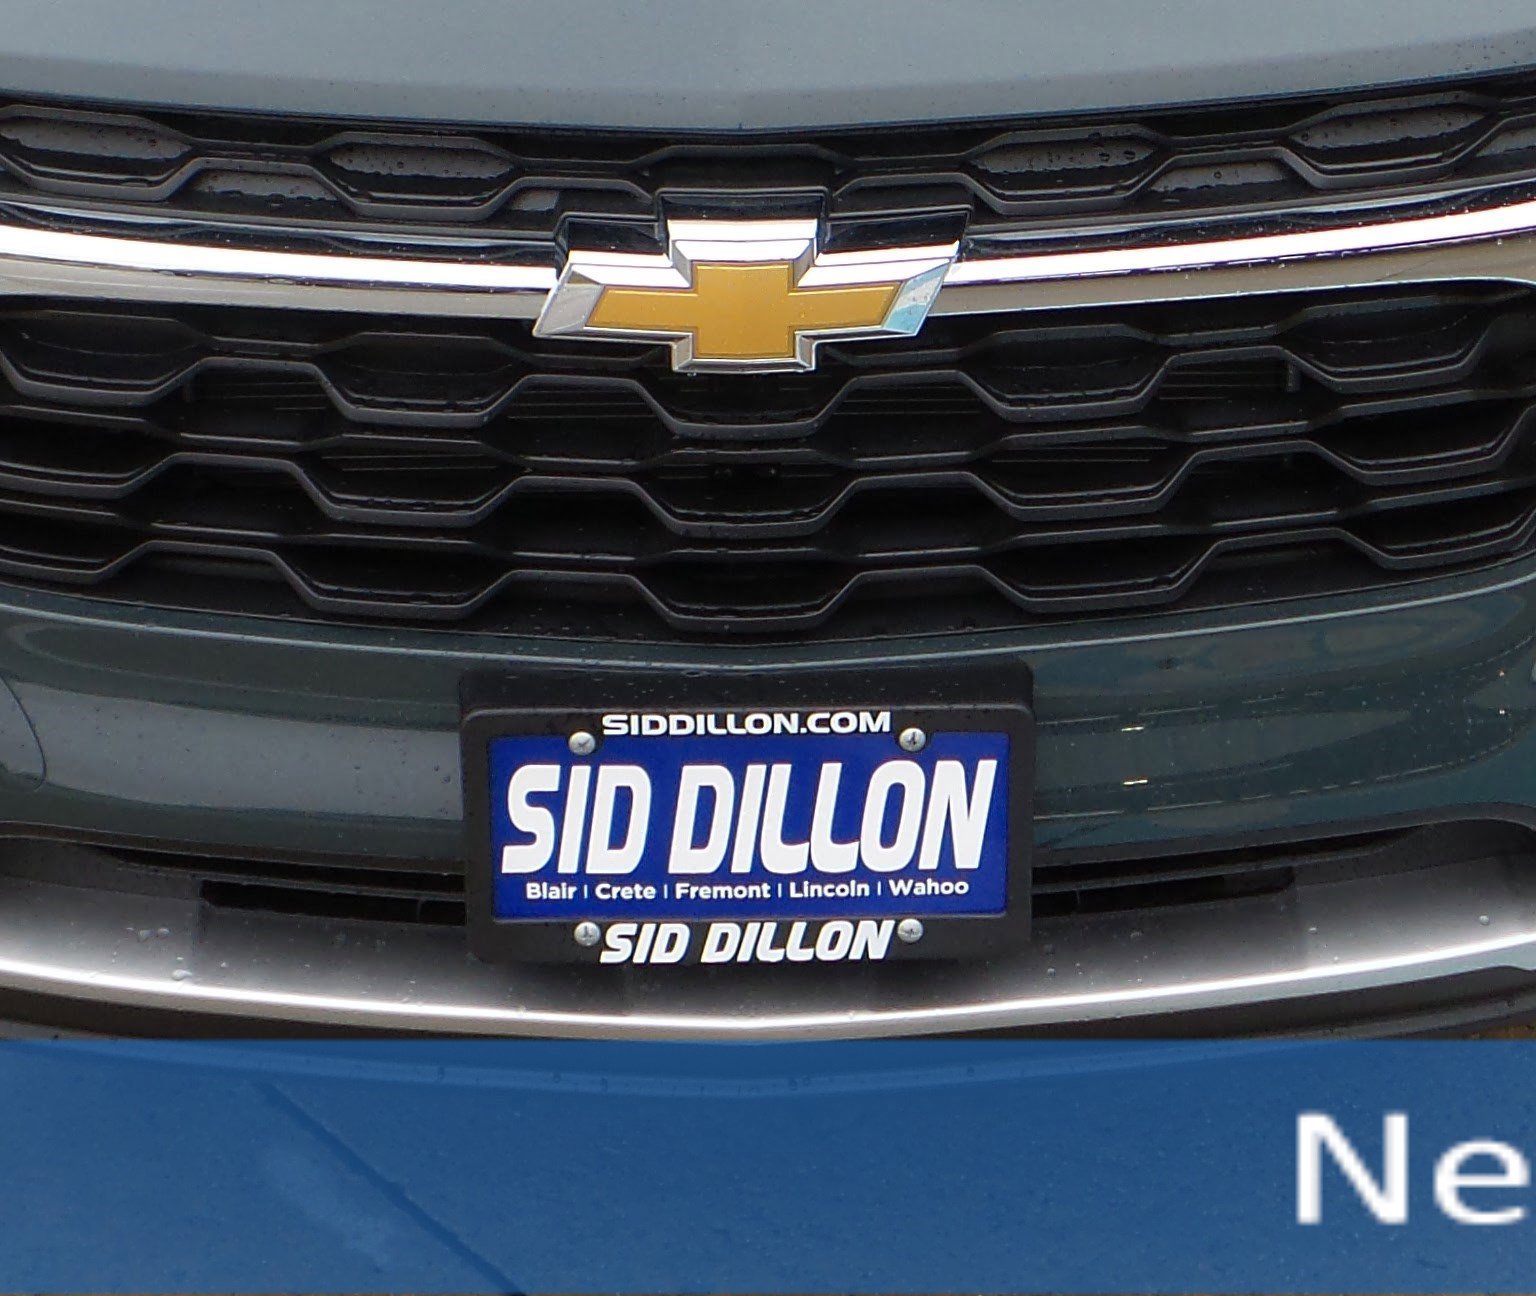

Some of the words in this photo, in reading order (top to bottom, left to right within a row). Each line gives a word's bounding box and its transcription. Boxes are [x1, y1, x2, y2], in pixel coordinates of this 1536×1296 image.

[601, 711, 892, 736] SIDDILLON.COM
[501, 764, 652, 875] SID
[668, 760, 998, 874] DILLON
[526, 881, 577, 900] Blair
[595, 882, 656, 900] Crete
[675, 881, 771, 900] Fremont
[789, 880, 870, 899] Lincoln
[889, 878, 969, 896] Wahoo
[599, 922, 689, 964] SID
[700, 919, 896, 964] DILLON
